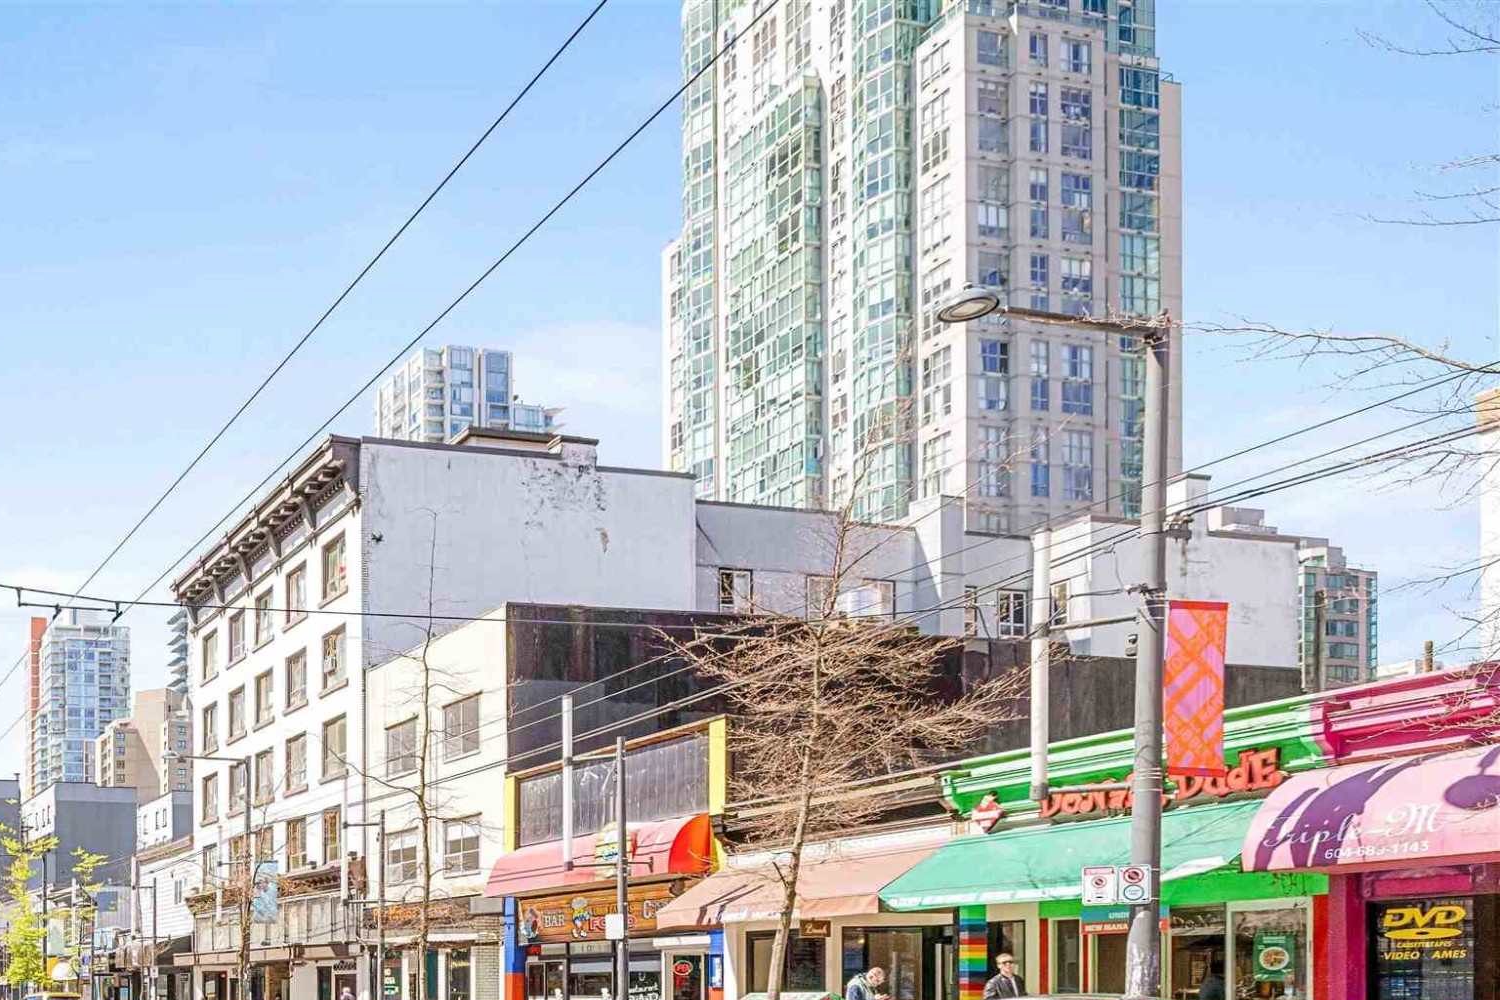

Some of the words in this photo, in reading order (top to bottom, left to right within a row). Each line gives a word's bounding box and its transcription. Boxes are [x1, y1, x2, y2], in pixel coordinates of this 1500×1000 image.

[590, 915, 635, 930] FOD
[1383, 905, 1467, 928] DVD
[1383, 951, 1420, 960] VIDEO
